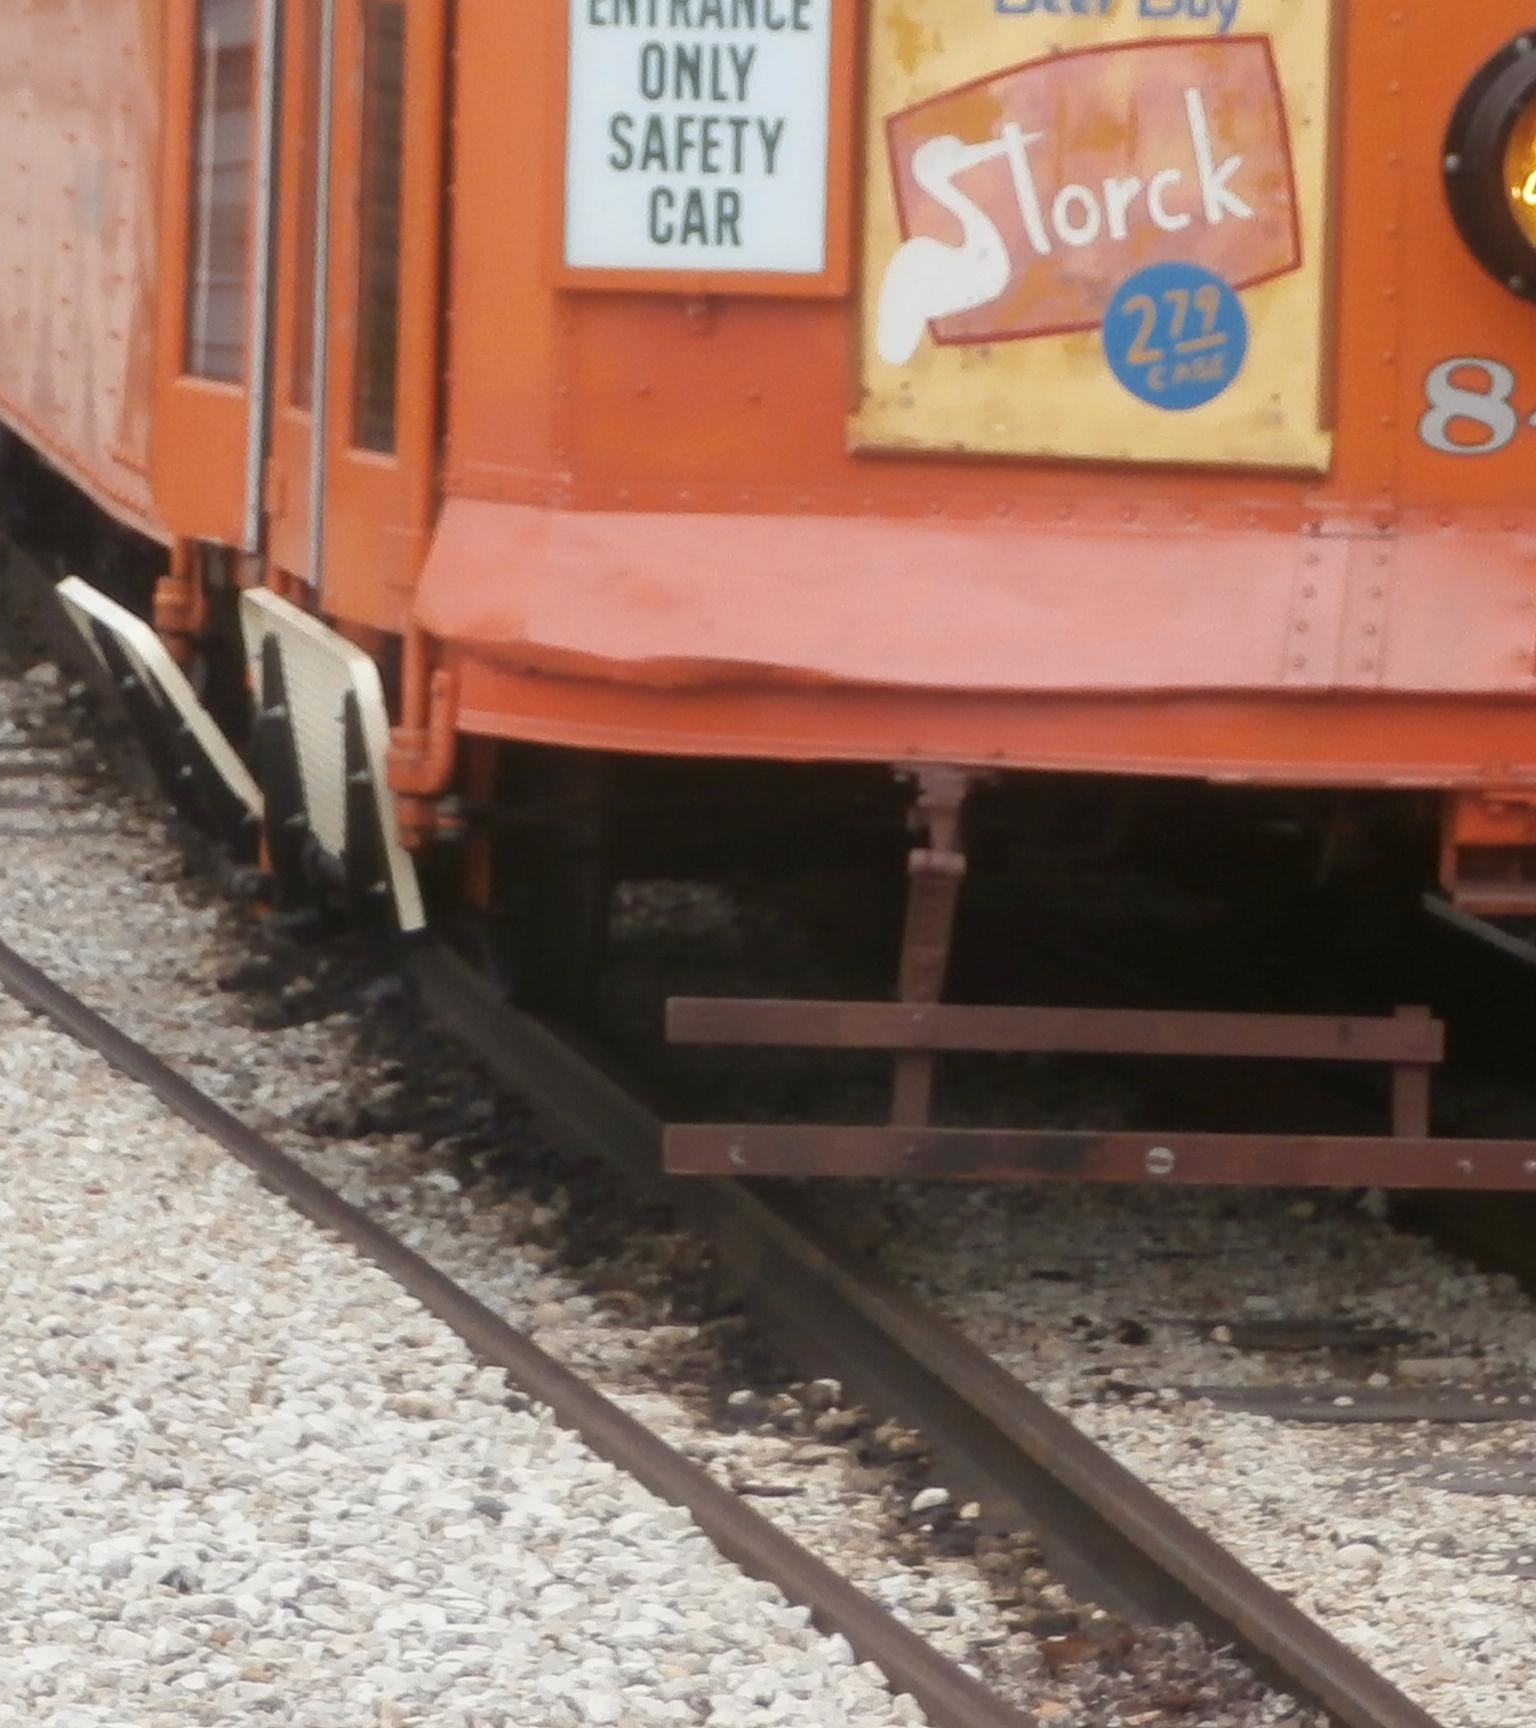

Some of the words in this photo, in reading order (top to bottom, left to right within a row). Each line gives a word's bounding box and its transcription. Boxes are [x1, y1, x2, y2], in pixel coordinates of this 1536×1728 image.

[639, 42, 757, 102] ONLY
[608, 112, 786, 175] SAFETY
[647, 185, 744, 246] CAR
[876, 87, 1256, 365] Storck
